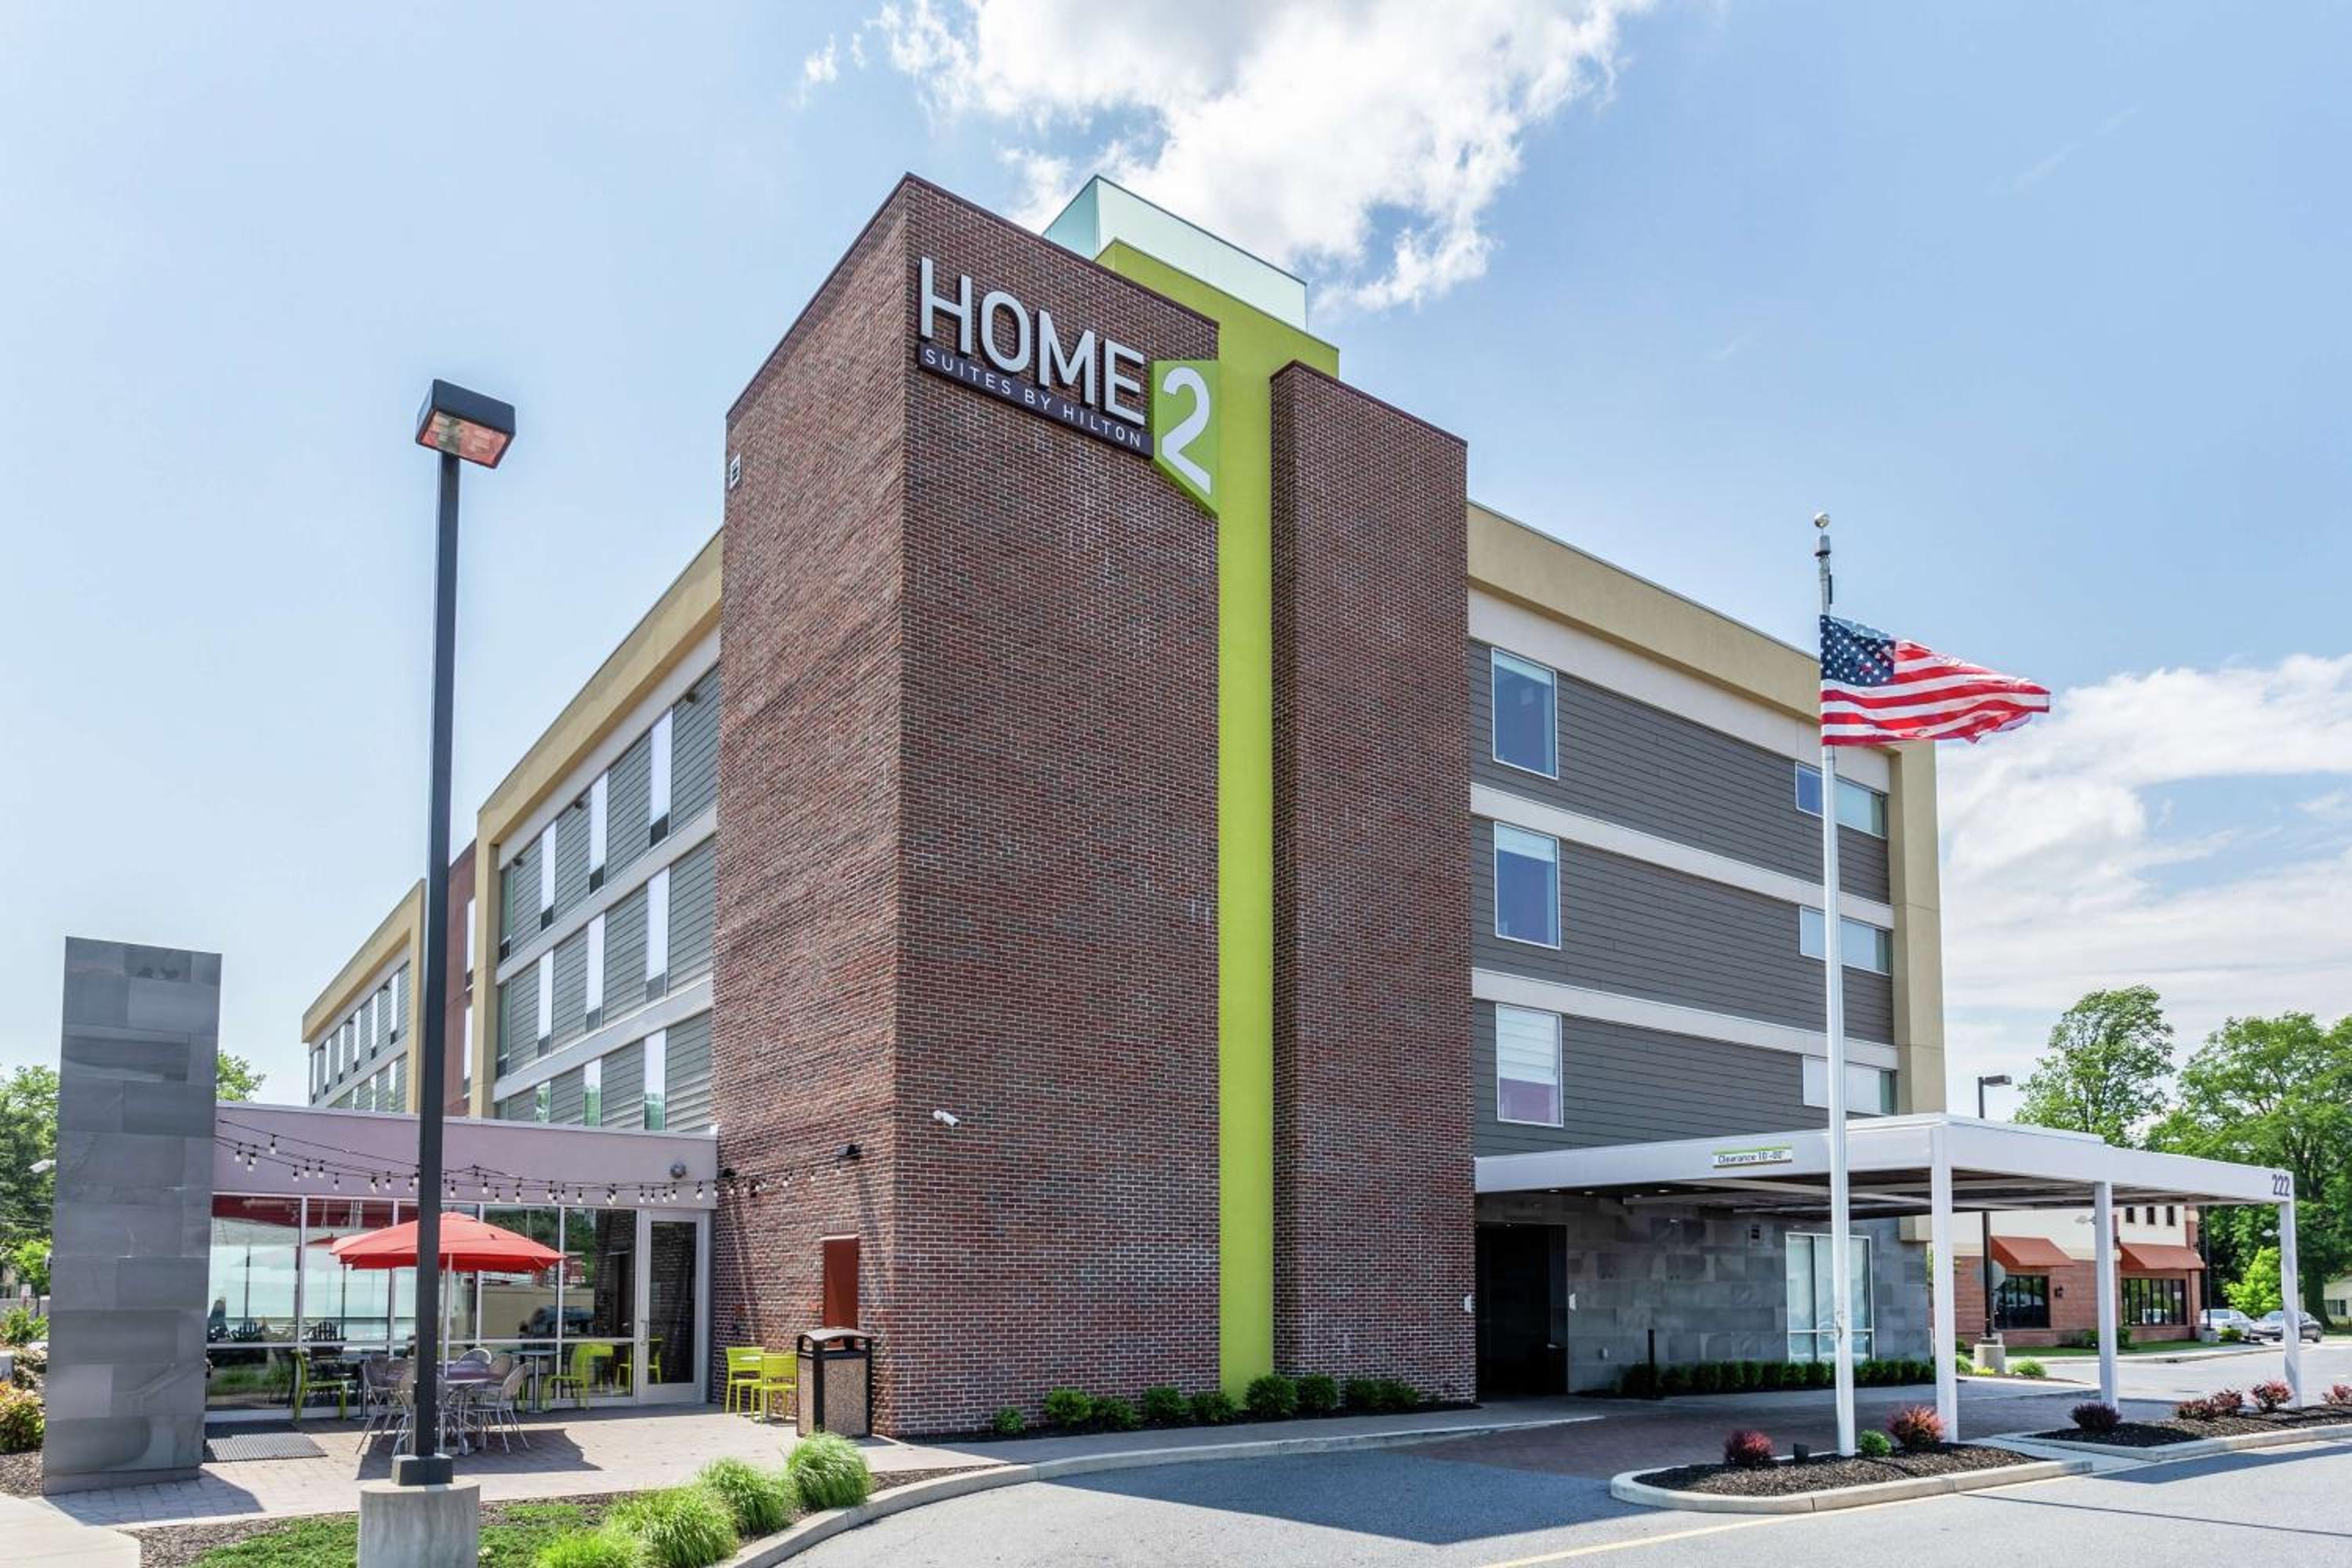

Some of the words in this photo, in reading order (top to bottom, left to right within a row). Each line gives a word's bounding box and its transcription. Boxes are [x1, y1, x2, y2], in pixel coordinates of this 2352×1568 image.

[919, 256, 1146, 426] HOME
[1161, 366, 1212, 495] 2
[925, 349, 1011, 394] SUITES
[1024, 389, 1052, 411] BY
[1063, 404, 1142, 448] HILTON
[1718, 1154, 1756, 1164] Clearance
[2271, 1174, 2290, 1196] 222
